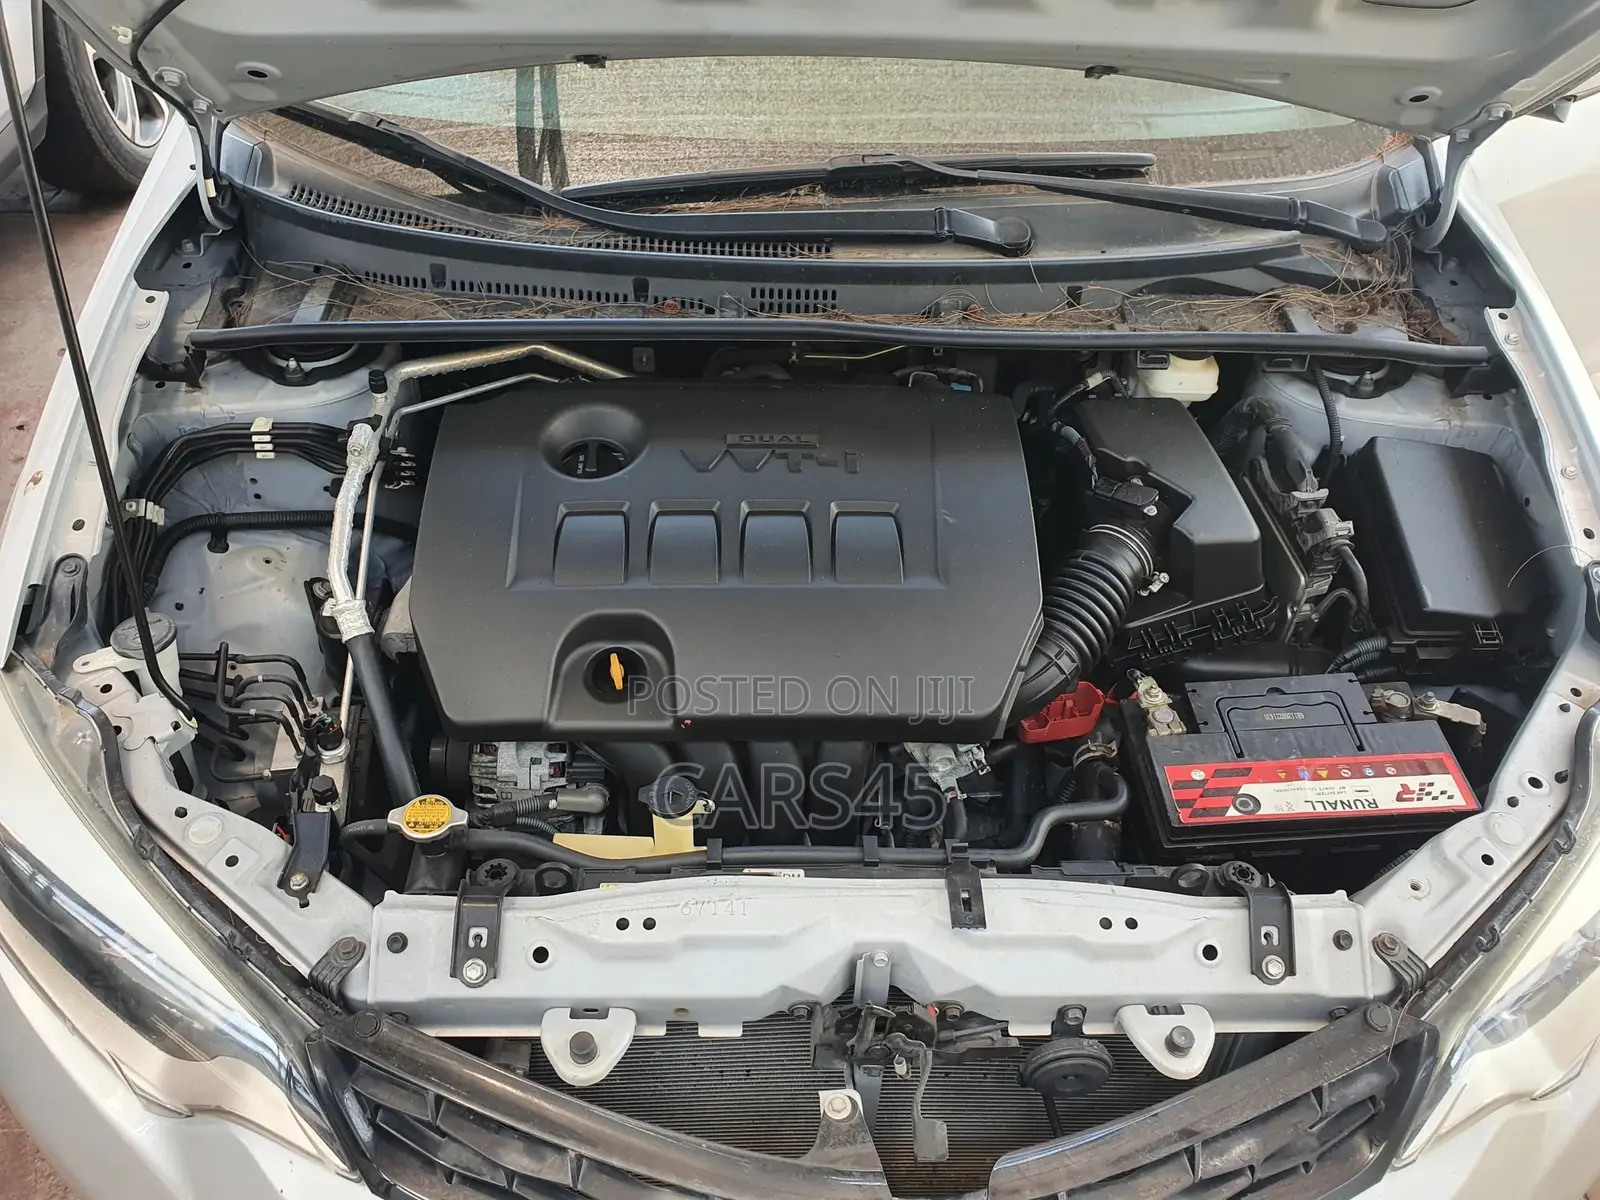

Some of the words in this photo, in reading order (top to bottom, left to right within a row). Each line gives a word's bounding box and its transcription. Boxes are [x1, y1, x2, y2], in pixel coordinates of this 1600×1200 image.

[738, 434, 812, 443] DUAL
[1304, 798, 1379, 812] RUNALL
[680, 898, 748, 916] 67141
